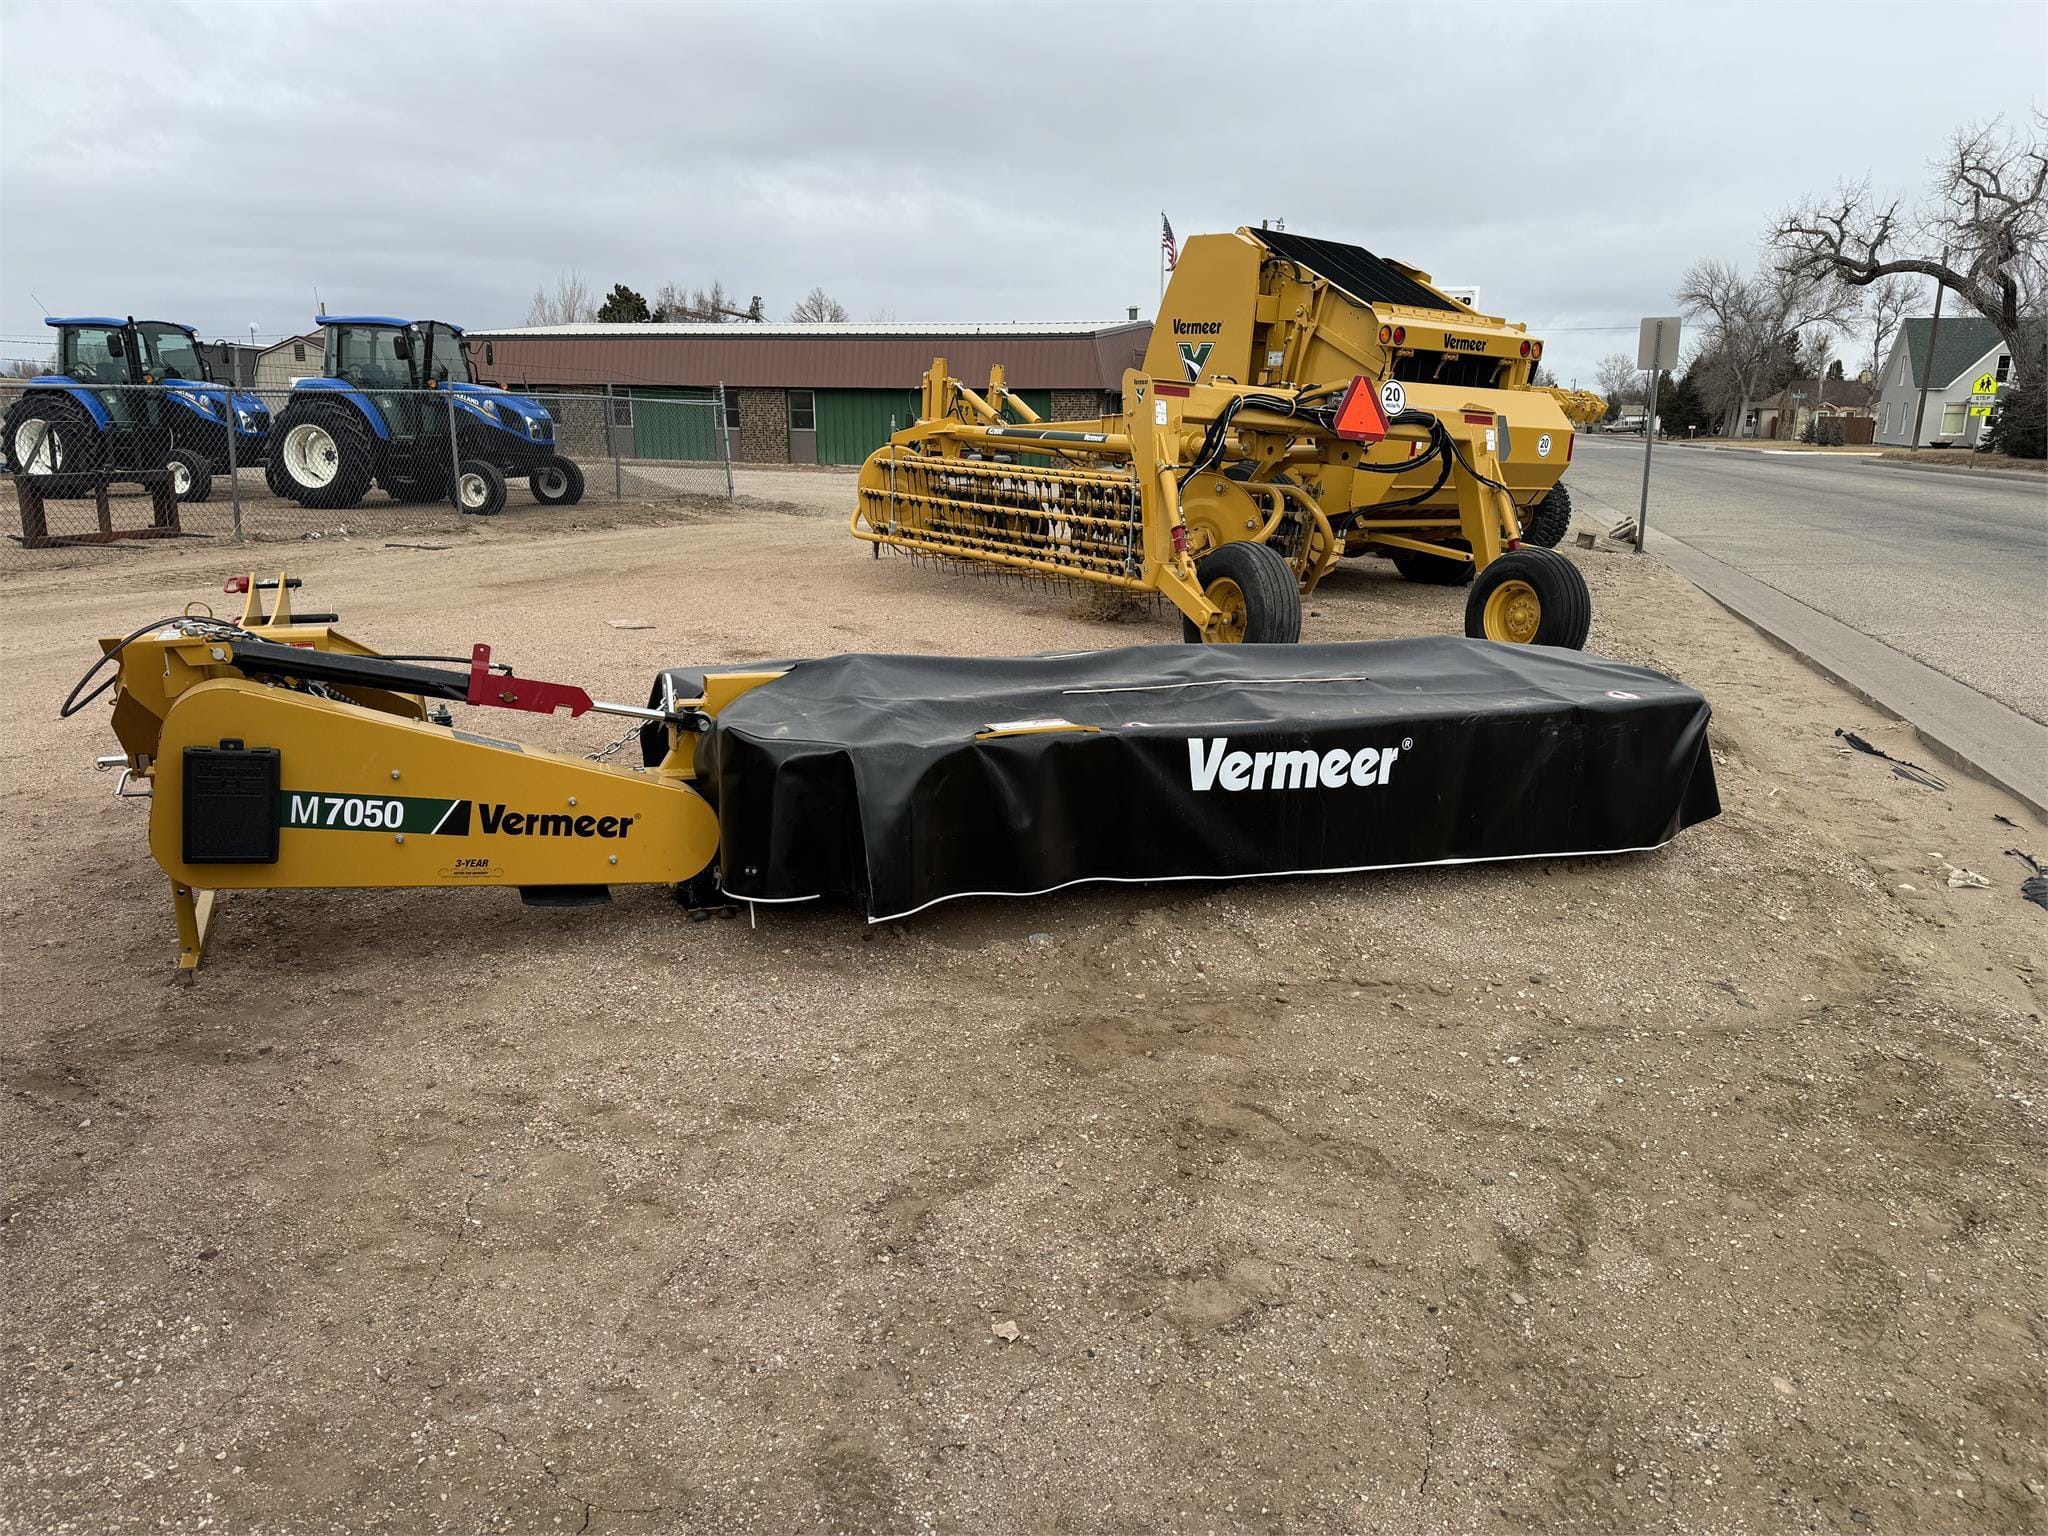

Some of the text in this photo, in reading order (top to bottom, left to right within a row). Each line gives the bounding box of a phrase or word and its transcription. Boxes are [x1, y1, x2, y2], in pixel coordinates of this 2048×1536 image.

[1385, 386, 1401, 402] 20
[1540, 438, 1549, 449] 20
[455, 858, 489, 868] 3-YEAR
